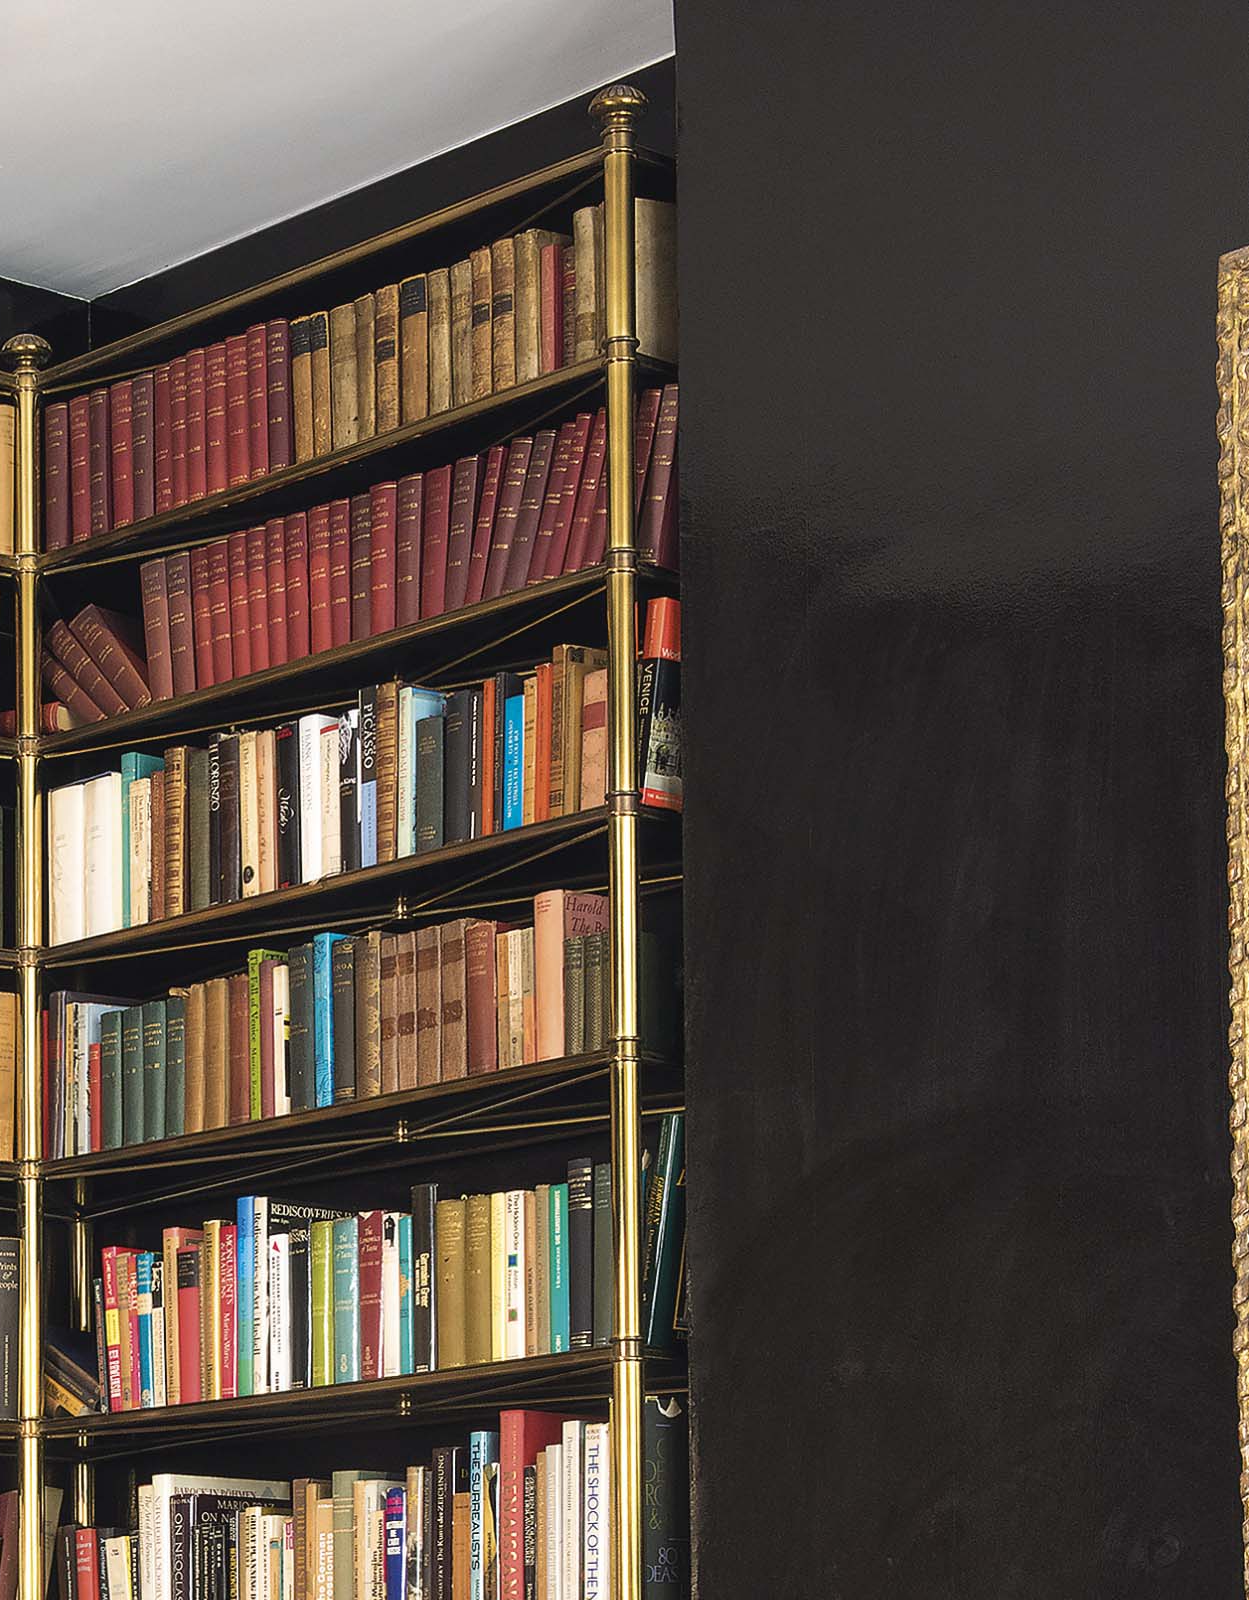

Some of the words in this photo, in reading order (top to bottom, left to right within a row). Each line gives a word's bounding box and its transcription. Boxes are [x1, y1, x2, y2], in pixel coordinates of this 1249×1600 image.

[639, 664, 654, 715] VENICE
[363, 703, 375, 769] PICASSO
[210, 758, 220, 811] LORENZO
[566, 897, 603, 912] Harold
[571, 917, 591, 932] The
[226, 1234, 234, 1305] MONUMENTS
[472, 1441, 481, 1468] THE
[587, 1444, 599, 1479] THE
[175, 1513, 184, 1538] ON
[471, 1472, 480, 1570] SURREALISTS
[587, 1481, 599, 1533] SHOCK
[317, 1533, 326, 1584] German
[587, 1537, 599, 1558] OF
[587, 1560, 599, 1590] THE
